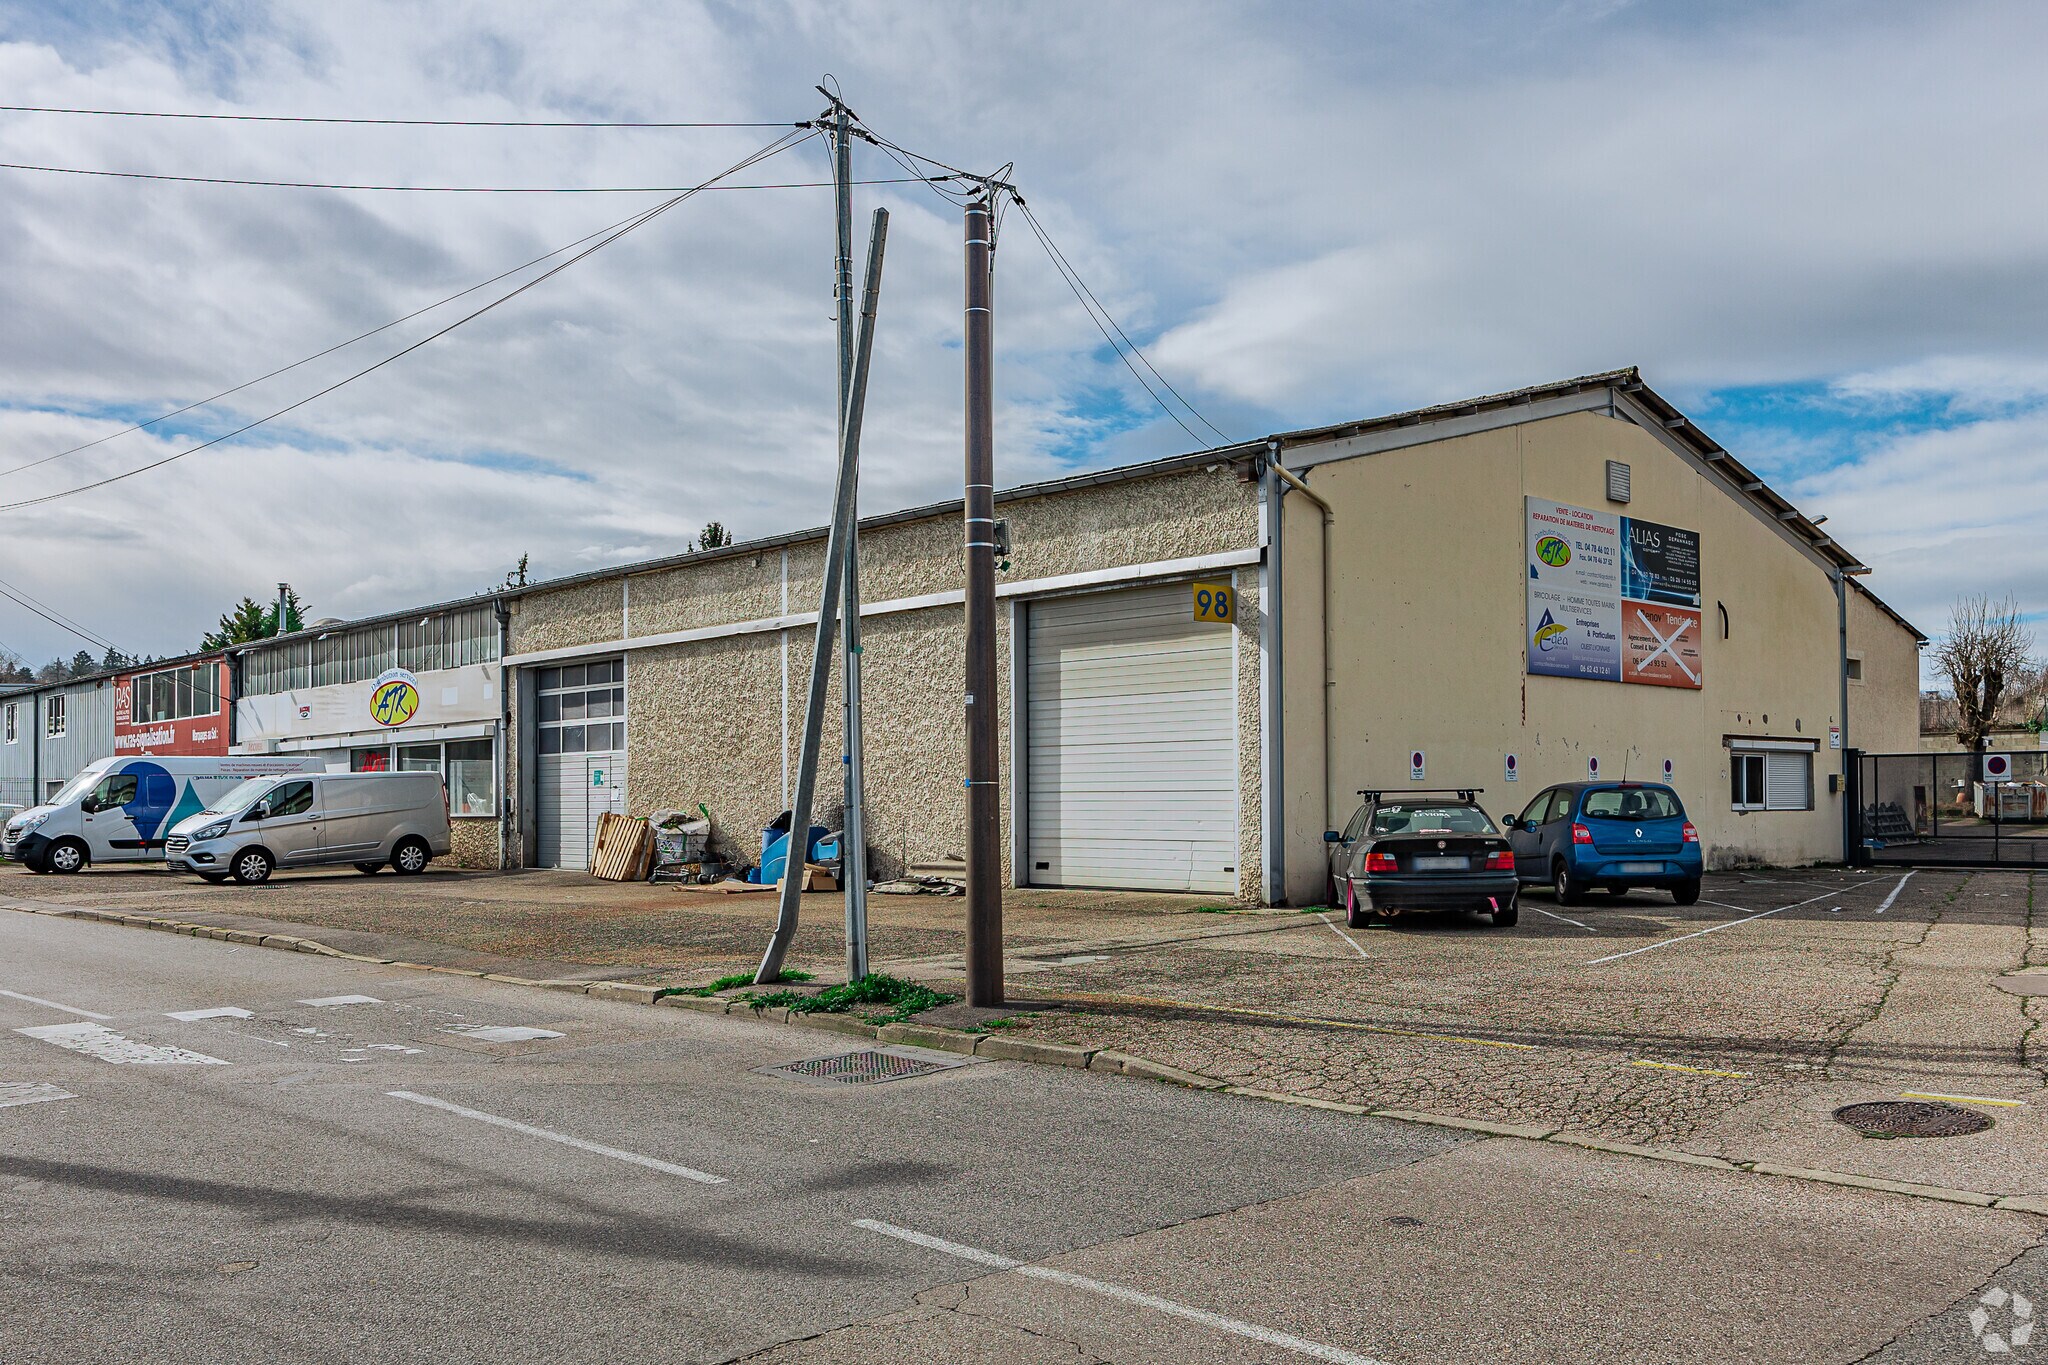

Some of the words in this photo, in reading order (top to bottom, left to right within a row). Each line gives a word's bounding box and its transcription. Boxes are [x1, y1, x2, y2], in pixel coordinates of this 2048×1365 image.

[1556, 507, 1568, 516] VENTE
[1572, 511, 1593, 520] LOCATION
[1592, 525, 1615, 535] NETTOYAGE
[1628, 527, 1660, 548] ALIAS
[1541, 540, 1564, 565] AJR
[1585, 543, 1590, 551] 04
[1604, 547, 1609, 555] 02
[1610, 548, 1616, 556] 11
[1197, 590, 1228, 618] 98
[1534, 591, 1561, 601] BRICOLAGE
[1567, 596, 1584, 605] HOMME
[1585, 599, 1600, 607] TOUTES
[1601, 601, 1615, 609] MAINS
[1560, 604, 1592, 615] MULTISERVICES
[1576, 618, 1599, 628] Entreprises
[1666, 613, 1698, 628] Tendace
[1593, 631, 1616, 640] Particuliers
[116, 686, 130, 709] RAS
[376, 684, 408, 724] AJR
